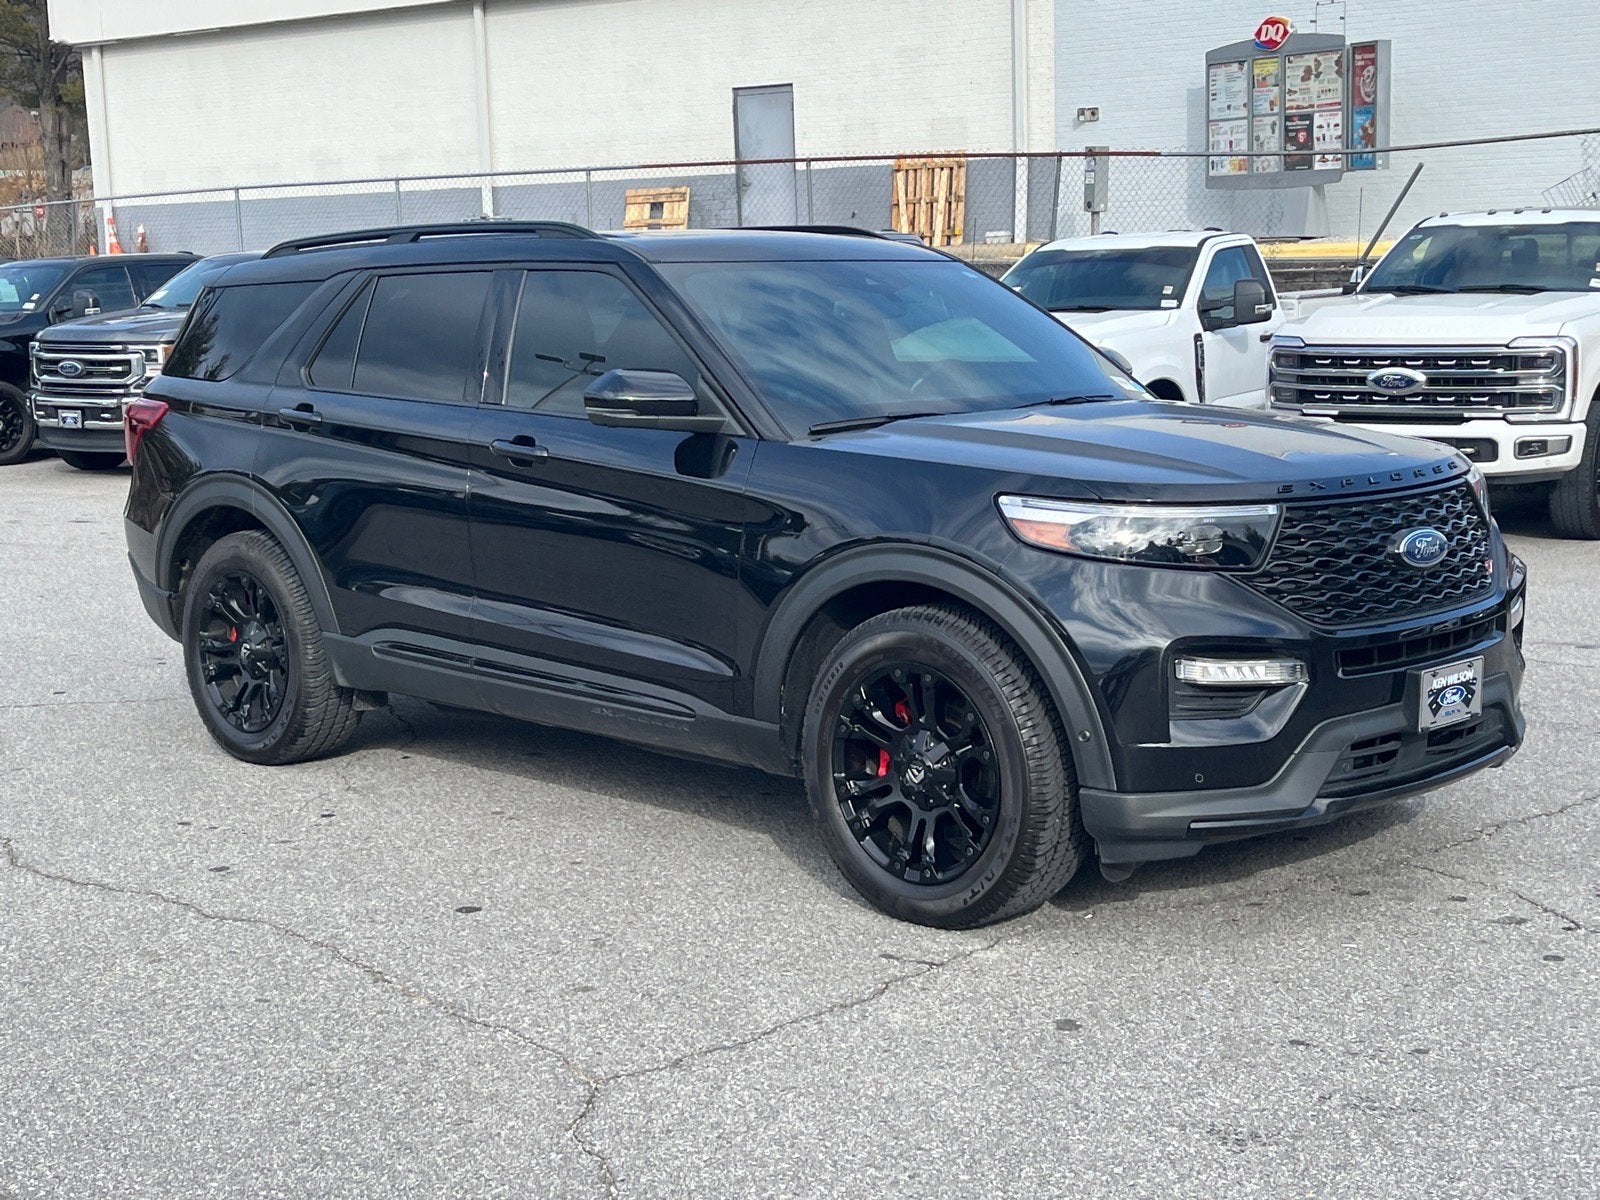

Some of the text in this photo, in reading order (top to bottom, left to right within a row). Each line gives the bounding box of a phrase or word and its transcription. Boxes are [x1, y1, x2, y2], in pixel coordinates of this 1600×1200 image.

[1260, 23, 1284, 42] DQ
[1380, 374, 1407, 388] Ford
[1277, 460, 1459, 494] EXPLORER
[1414, 536, 1440, 559] Ford
[1431, 668, 1474, 690] KEN WILSON
[1443, 688, 1461, 705] Ford
